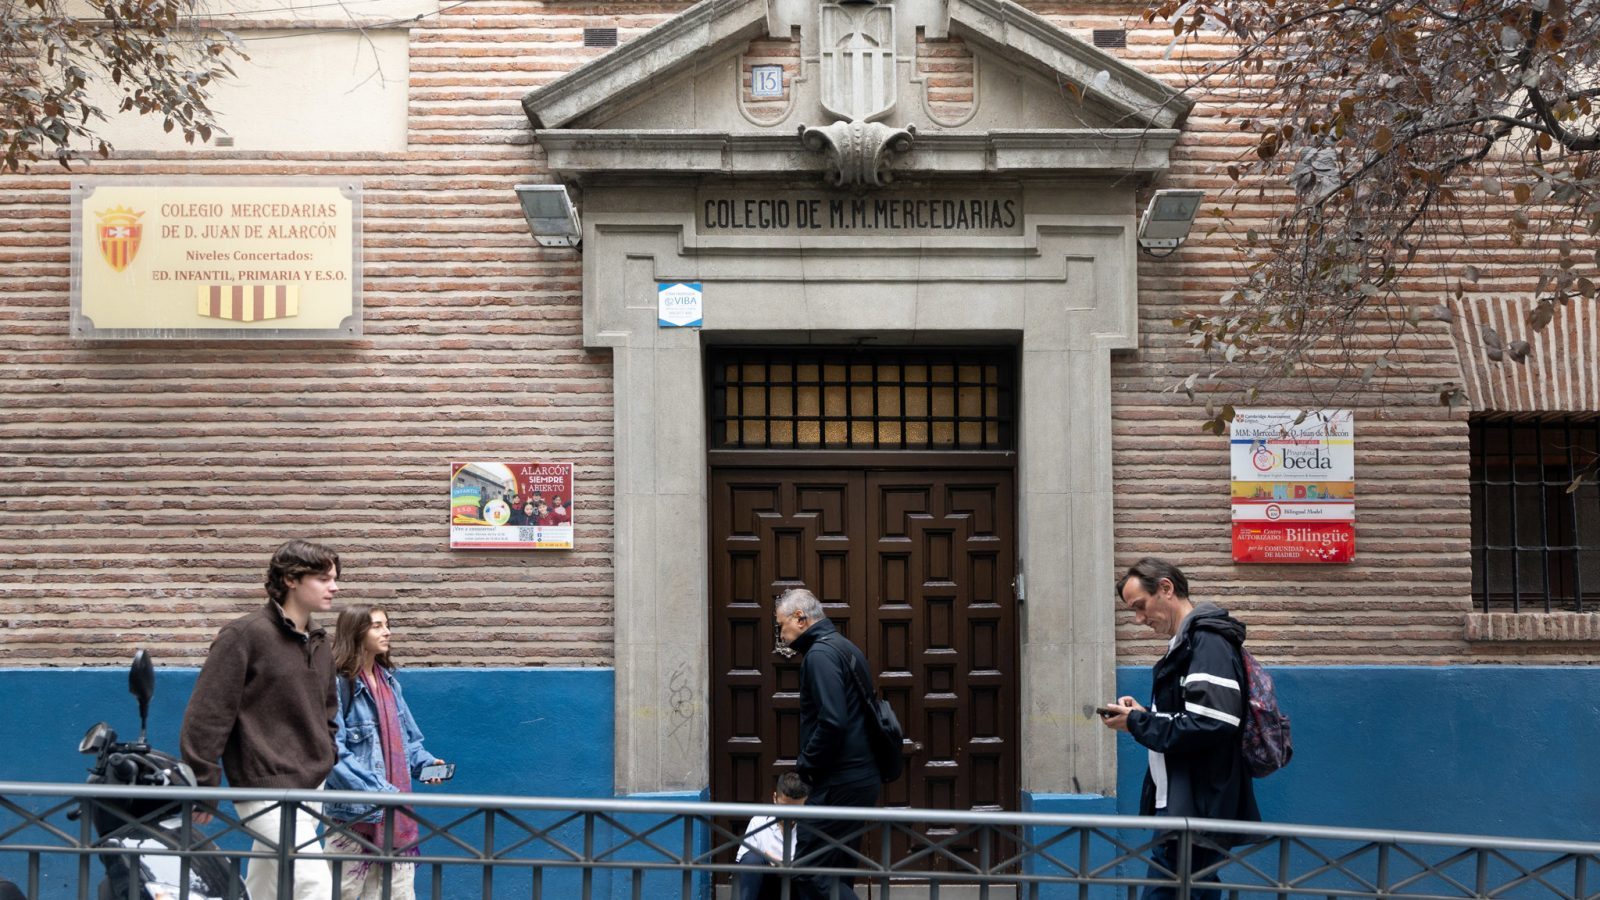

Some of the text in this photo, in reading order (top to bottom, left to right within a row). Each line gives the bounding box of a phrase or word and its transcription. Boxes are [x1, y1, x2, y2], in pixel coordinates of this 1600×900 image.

[760, 71, 776, 90] 15
[161, 203, 337, 218] COLEGIO MERCEDARIAS
[704, 199, 789, 229] COLEGIO
[797, 199, 821, 229] DE
[161, 221, 337, 239] DE D. JUAN DE ALARCÓN
[186, 250, 314, 261] Niveles Concertados:
[152, 271, 347, 283] ED. INFANTIL, PRIMARIA Y E.S.O.
[675, 297, 697, 305] VIBA
[1283, 448, 1332, 470] beda
[521, 465, 569, 475] ALARCÓN
[528, 484, 565, 492] ABIERTO
[1286, 528, 1349, 546] Bilingüe
